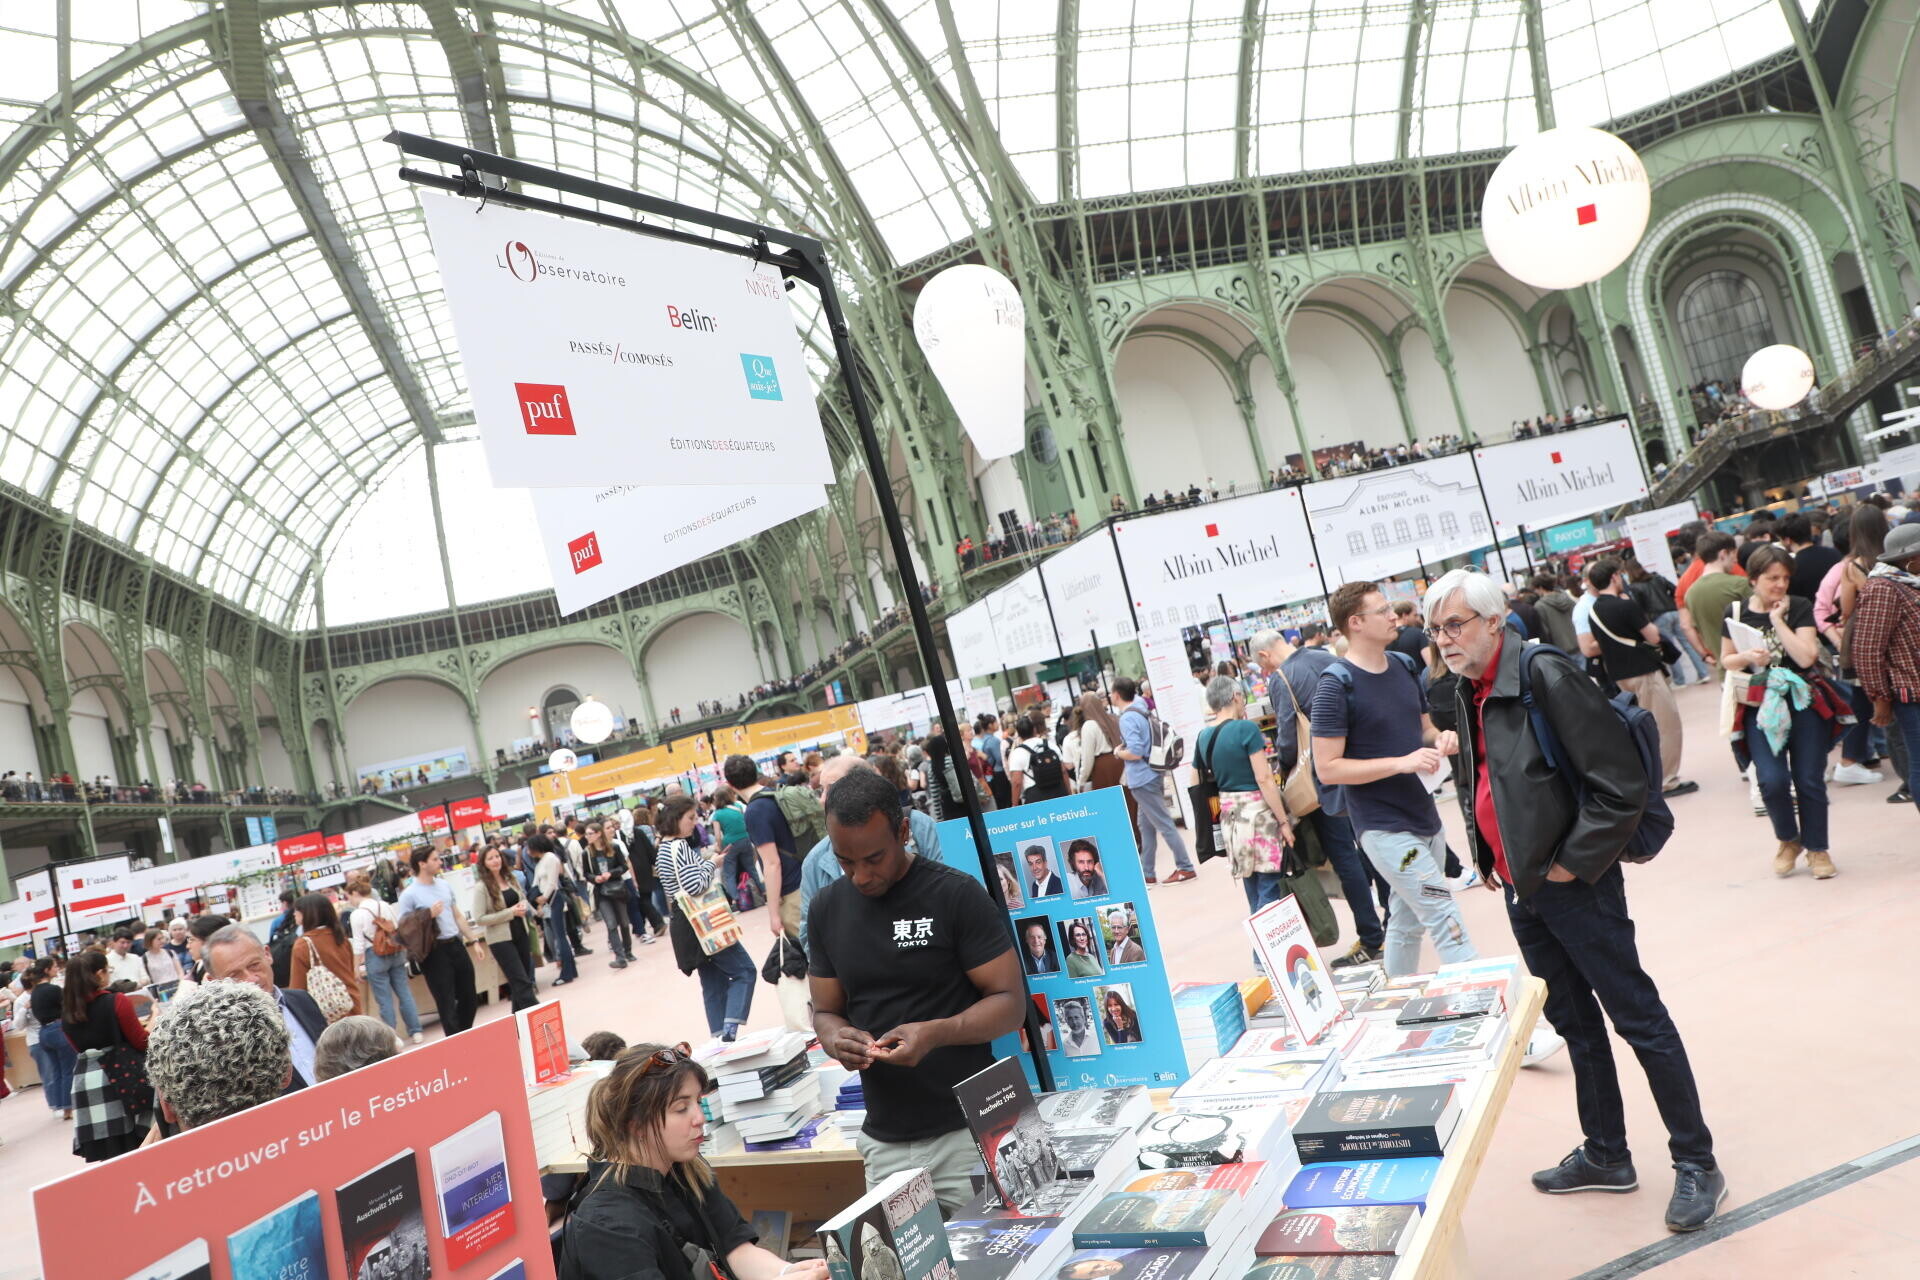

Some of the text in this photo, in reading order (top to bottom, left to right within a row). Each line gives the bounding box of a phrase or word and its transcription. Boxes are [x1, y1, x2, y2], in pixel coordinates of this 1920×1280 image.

[745, 279, 780, 300] NN16
[525, 393, 563, 427] puf
[1517, 463, 1615, 505] Albin Michel
[1391, 495, 1432, 510] MICHEL
[1554, 527, 1589, 543] PAYOT
[573, 538, 594, 569] puf
[1162, 535, 1281, 583] Albin Michel
[1020, 818, 1035, 830] sur
[1037, 815, 1047, 827] le
[306, 863, 342, 880] POINTS
[892, 917, 934, 941] 東京
[1265, 914, 1301, 942] INFOGRAPHIE
[897, 939, 929, 948] TOKYO
[979, 1091, 1017, 1117] Auschwitz 1945
[1379, 1139, 1411, 1150] HISTOIRE
[133, 1182, 157, 1215] À
[165, 1137, 289, 1201] retrouver
[298, 1119, 333, 1147] sur
[341, 1107, 362, 1130] le
[485, 1171, 503, 1187] MER
[356, 1192, 404, 1224] Auschwitz 1945
[461, 1182, 504, 1213] INTÉRIEURE
[987, 1224, 1024, 1257] CHARLES
[998, 1224, 1036, 1255] PASQUA
